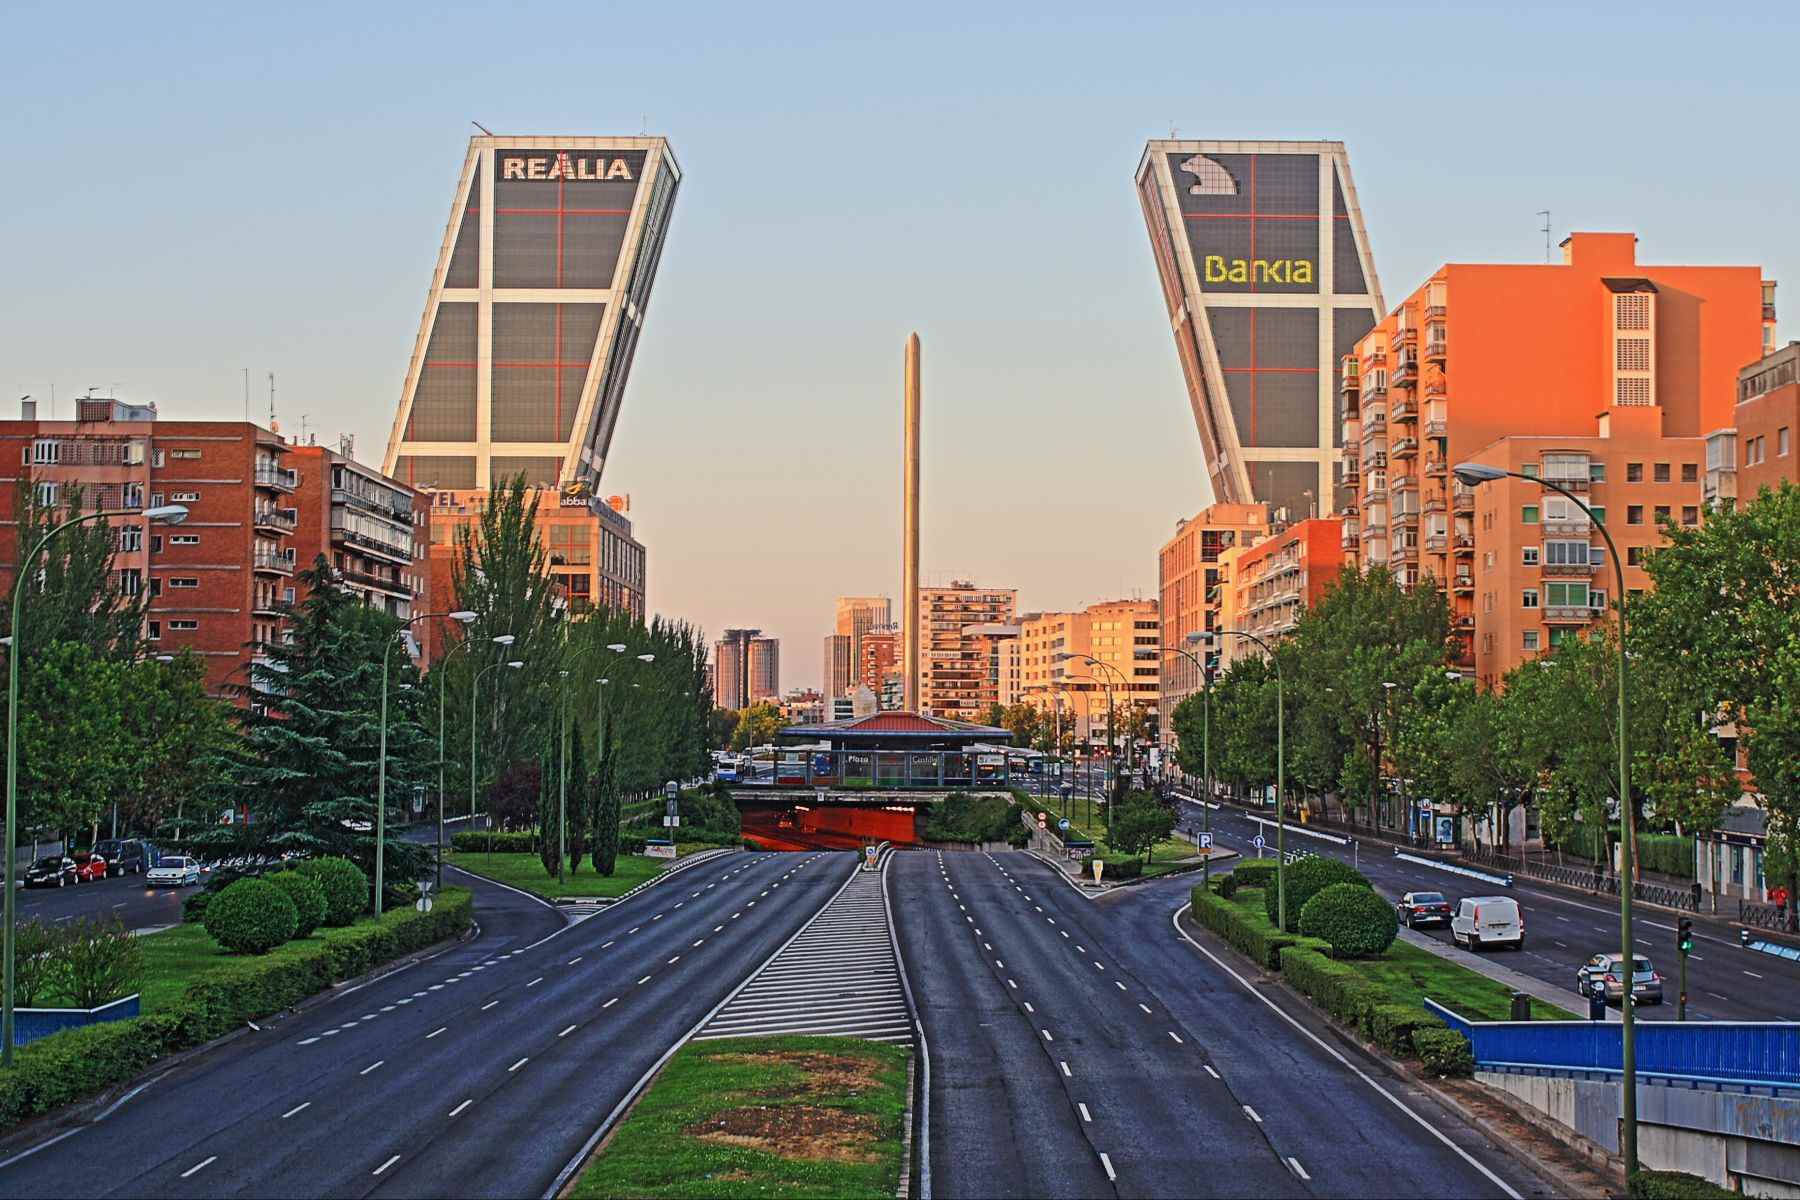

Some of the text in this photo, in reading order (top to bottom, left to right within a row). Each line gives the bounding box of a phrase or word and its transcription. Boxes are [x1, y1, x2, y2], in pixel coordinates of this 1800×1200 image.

[503, 153, 632, 180] REALIA
[1205, 256, 1313, 283] Bankia
[560, 496, 586, 506] abba
[848, 755, 869, 763] Plaza
